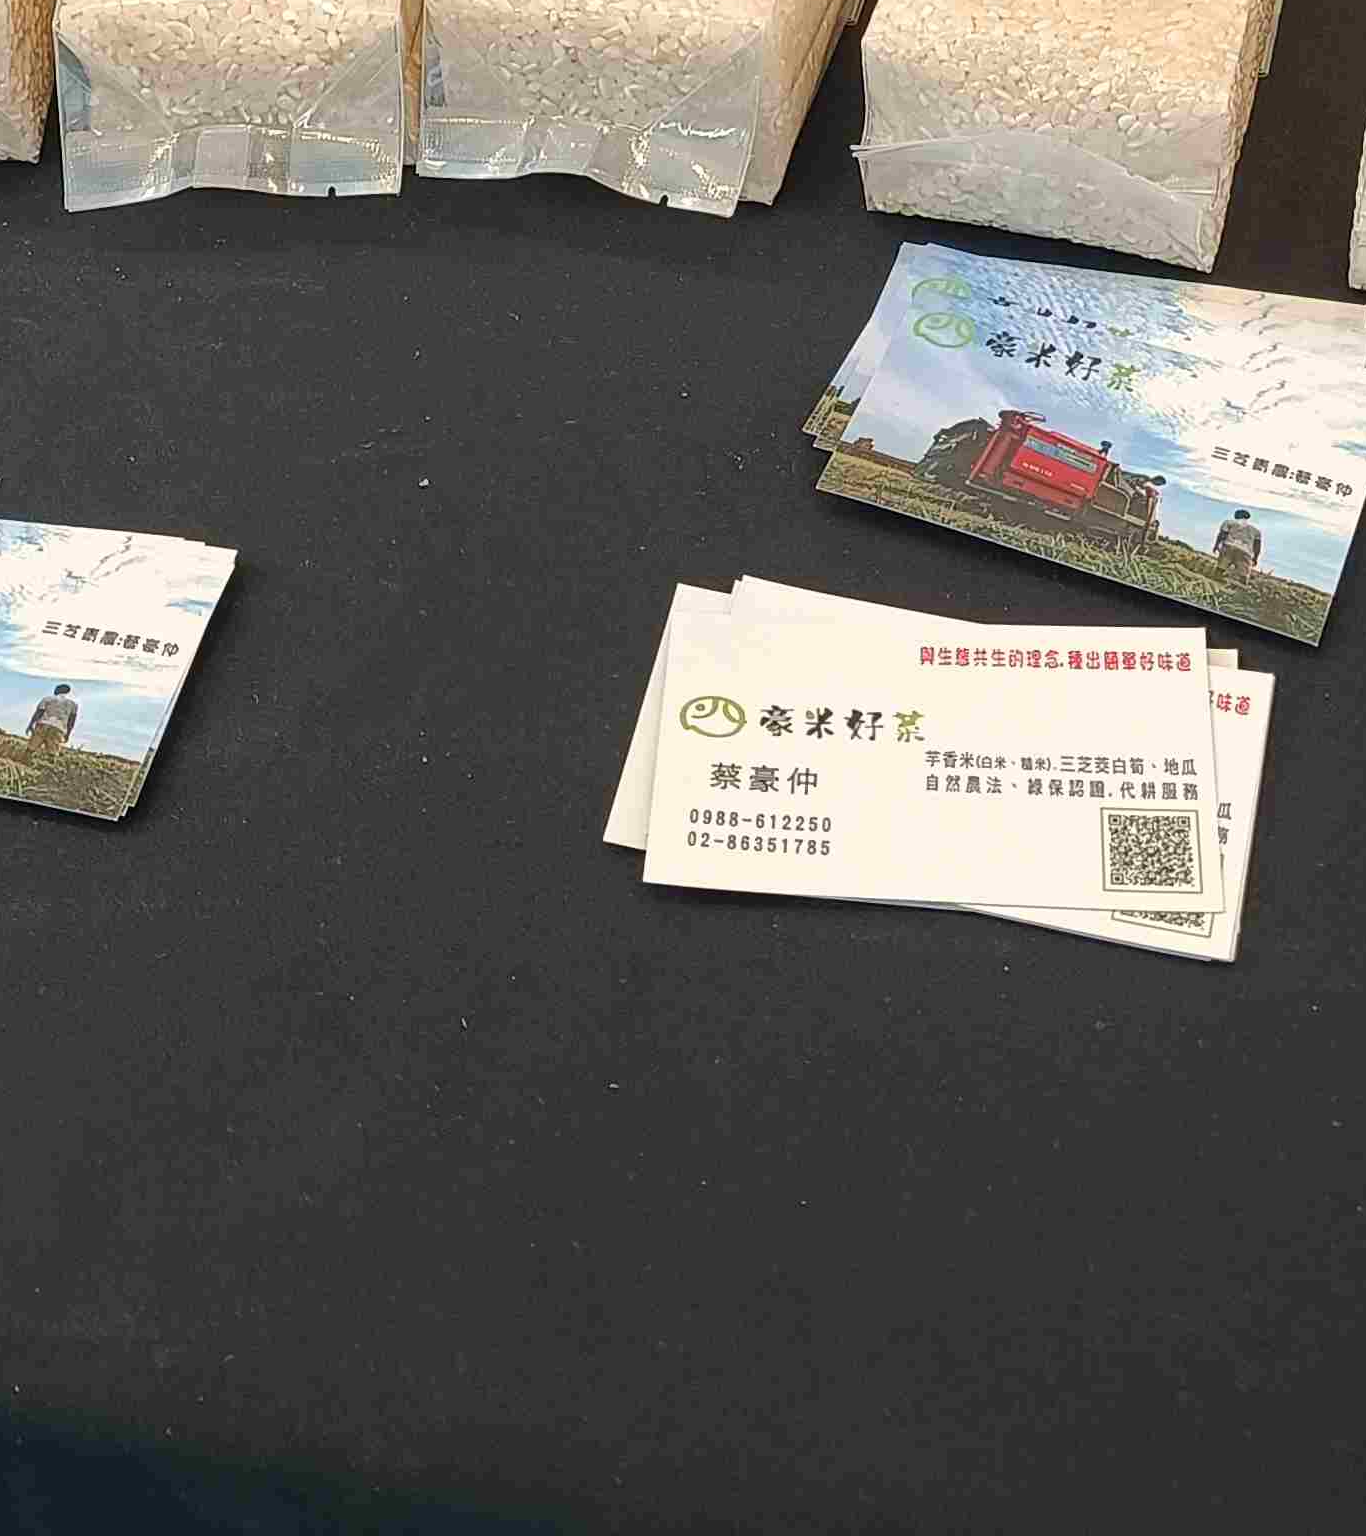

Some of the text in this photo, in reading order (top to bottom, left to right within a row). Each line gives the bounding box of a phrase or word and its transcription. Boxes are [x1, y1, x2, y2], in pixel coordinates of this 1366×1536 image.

[759, 703, 926, 744] 豪米好菜
[708, 761, 819, 796] 蔡豪仲
[688, 807, 833, 834] 0988-612250
[687, 830, 832, 857] 02-86351785
